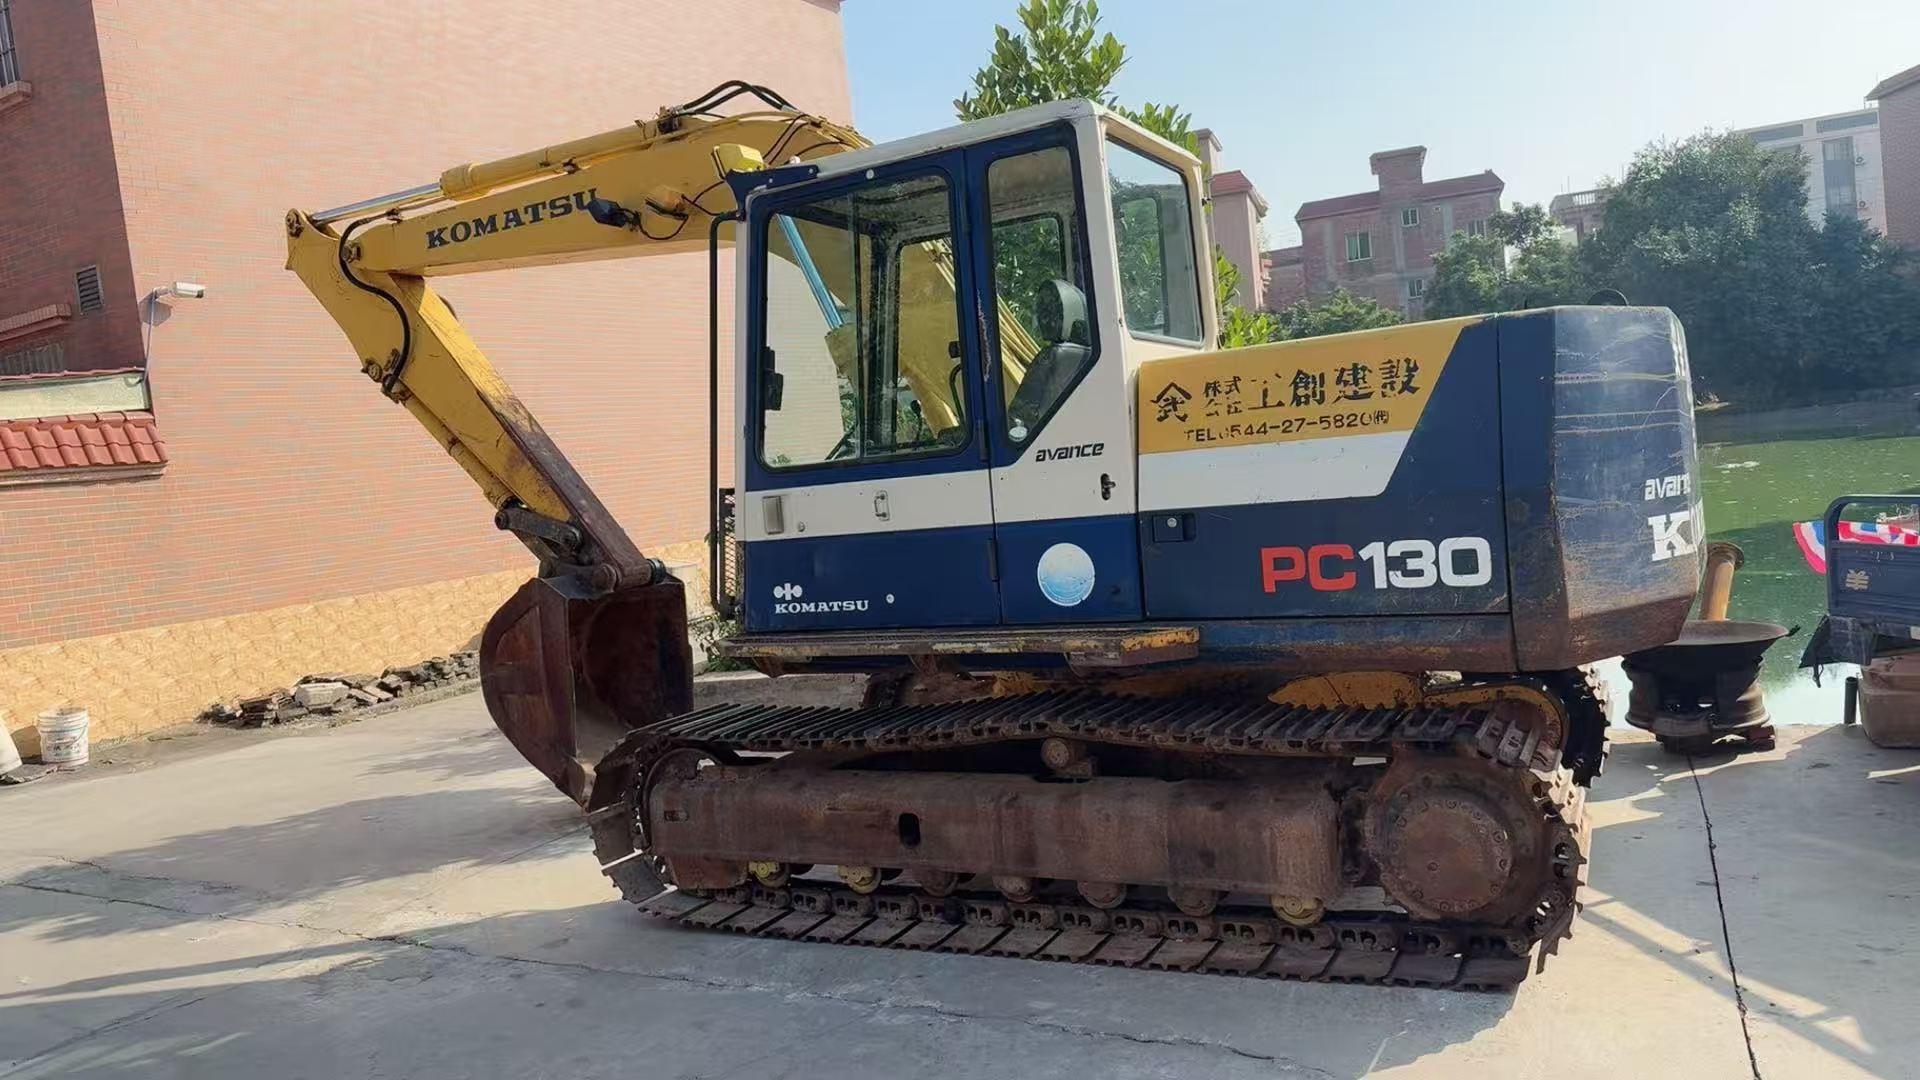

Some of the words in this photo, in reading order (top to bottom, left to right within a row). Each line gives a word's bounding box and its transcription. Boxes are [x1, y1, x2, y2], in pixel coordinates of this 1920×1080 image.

[426, 187, 597, 249] KOMATSU
[1183, 428, 1217, 441] TEL
[1035, 442, 1105, 462] avance
[1260, 536, 1493, 593] PC130
[774, 599, 869, 614] KOMATSU
